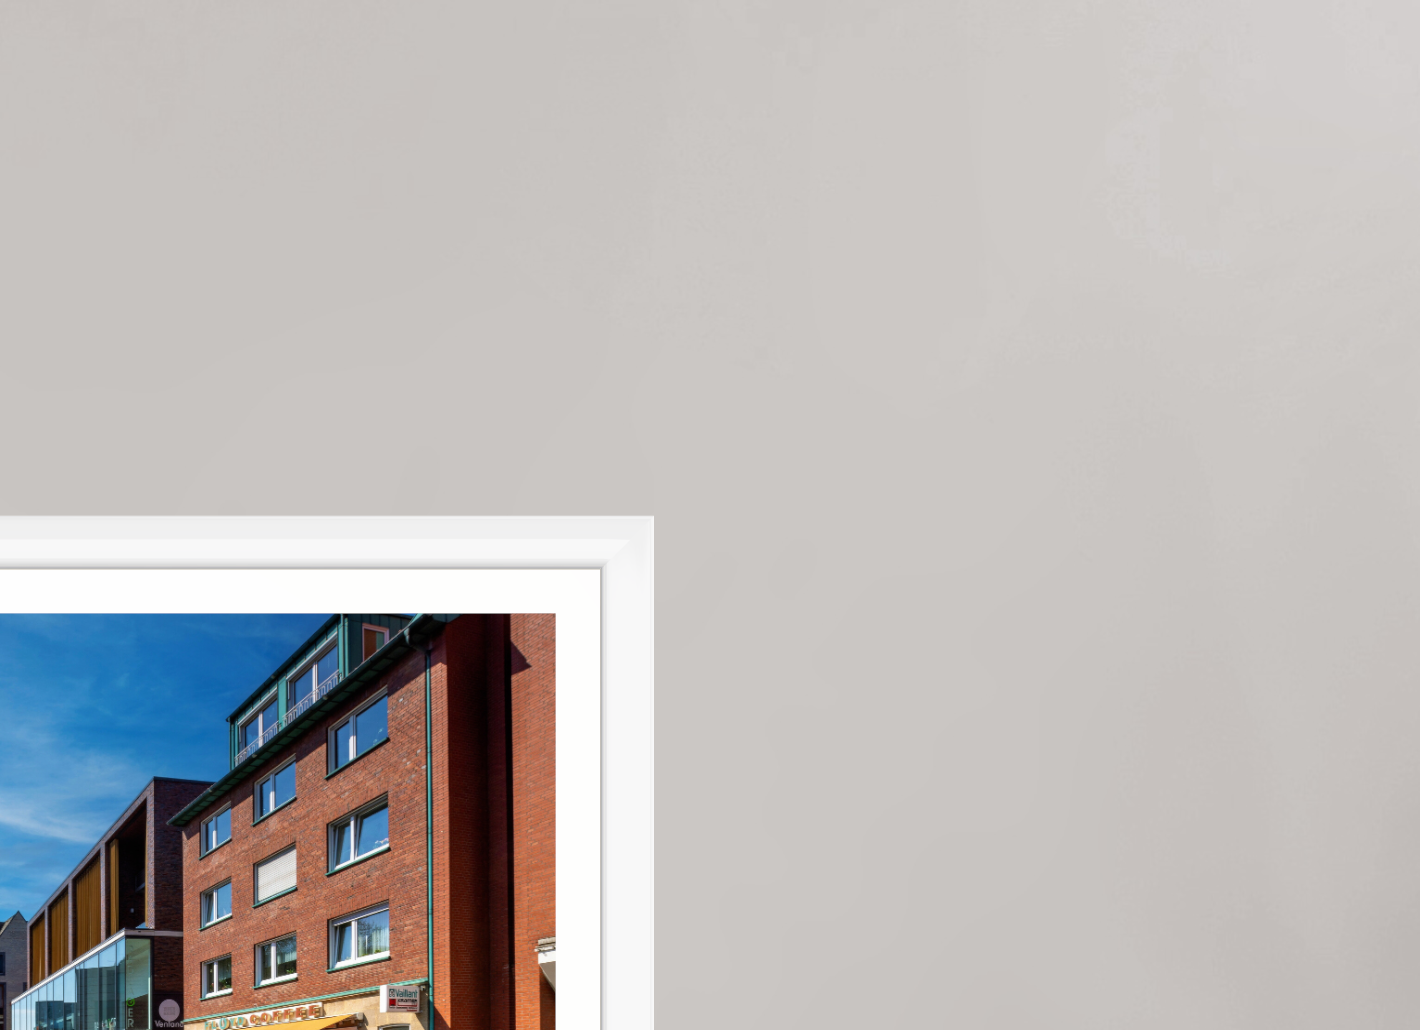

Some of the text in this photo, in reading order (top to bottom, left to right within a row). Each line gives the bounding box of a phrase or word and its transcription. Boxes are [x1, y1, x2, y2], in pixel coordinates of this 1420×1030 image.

[395, 989, 418, 998] Vaillant
[204, 1005, 322, 1030] FLOYD COFFEE
